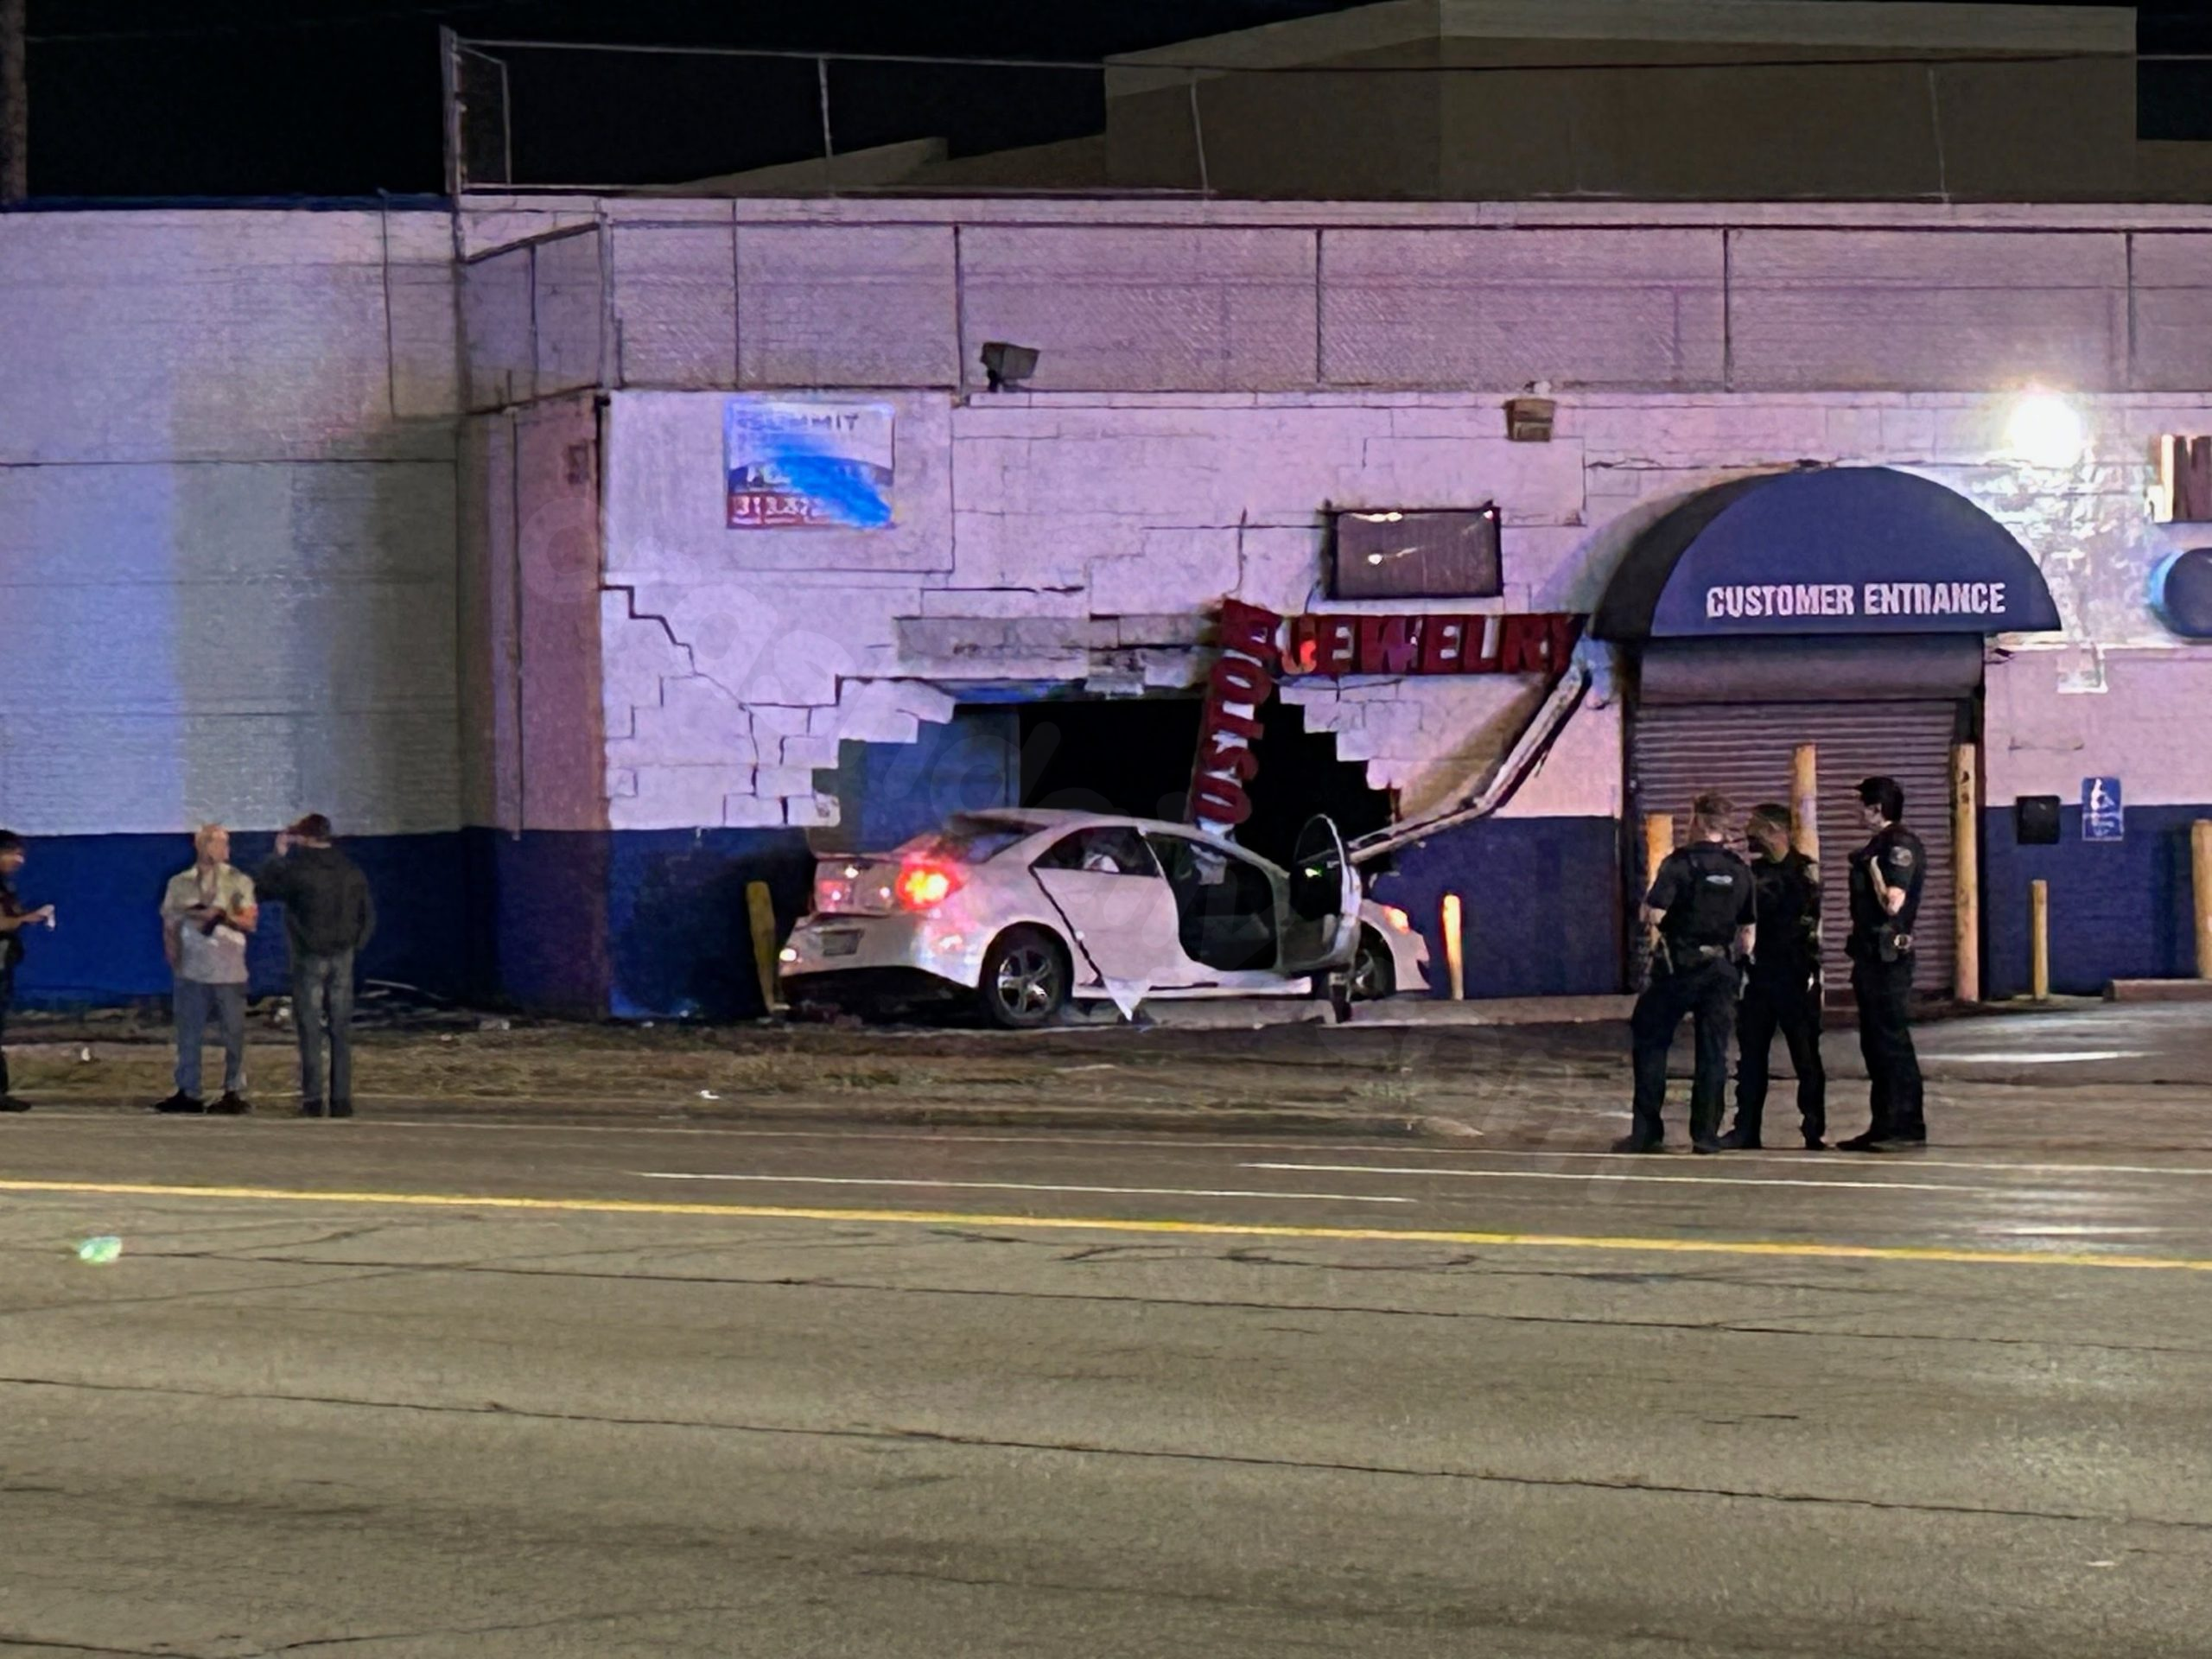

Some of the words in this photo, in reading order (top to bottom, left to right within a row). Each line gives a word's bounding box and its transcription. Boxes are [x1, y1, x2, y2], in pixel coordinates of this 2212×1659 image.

[735, 410, 859, 431] MMIT
[1707, 585, 1855, 618] CUSTOMER
[1864, 582, 2006, 614] ENTRANCE
[1192, 599, 1281, 824] USTOM
